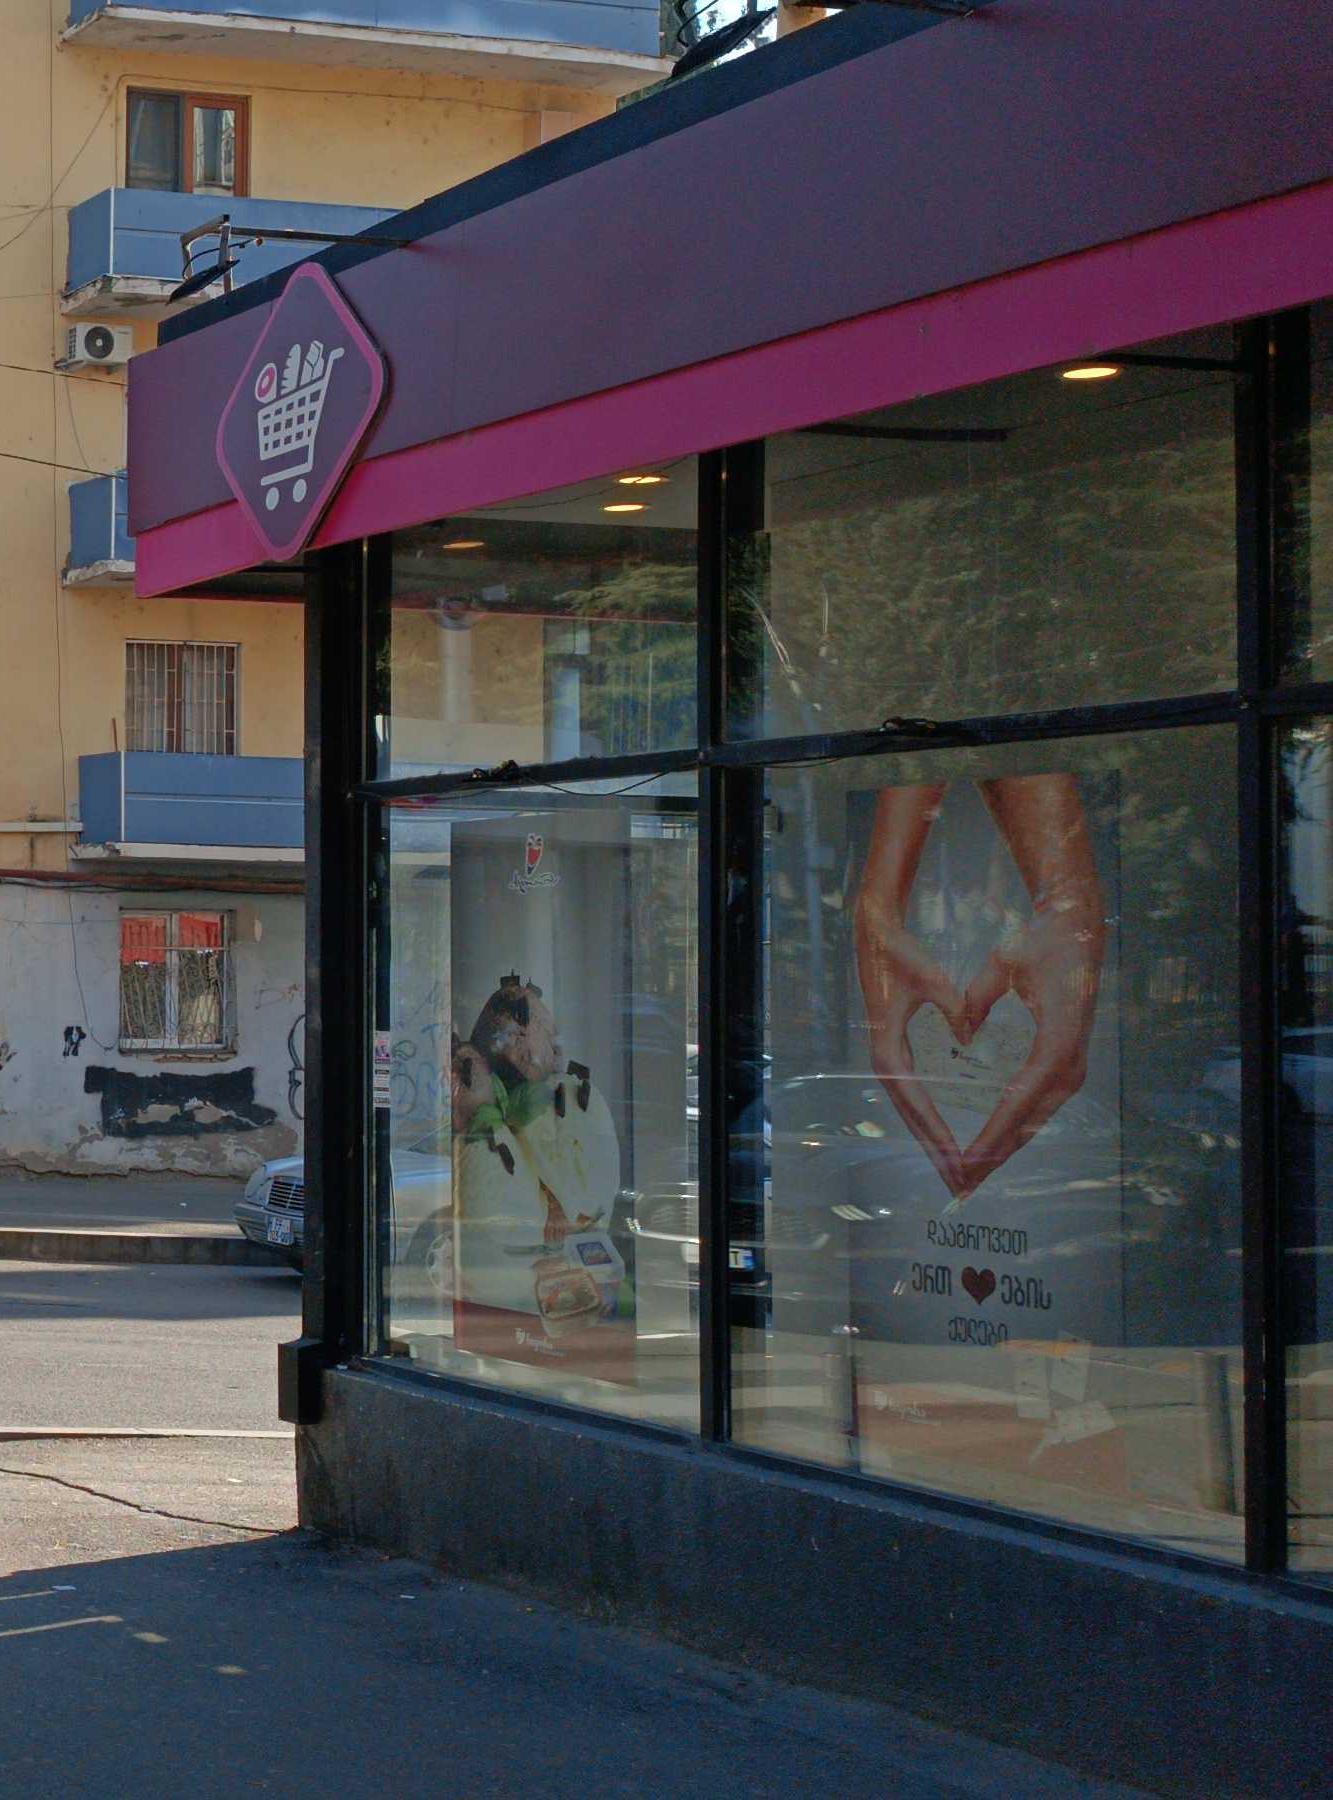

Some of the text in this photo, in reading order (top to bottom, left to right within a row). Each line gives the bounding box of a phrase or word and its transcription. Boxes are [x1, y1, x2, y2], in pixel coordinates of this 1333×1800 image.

[926, 1219, 1028, 1256] დააგროვეთ
[911, 1262, 1052, 1310] ერთ ების
